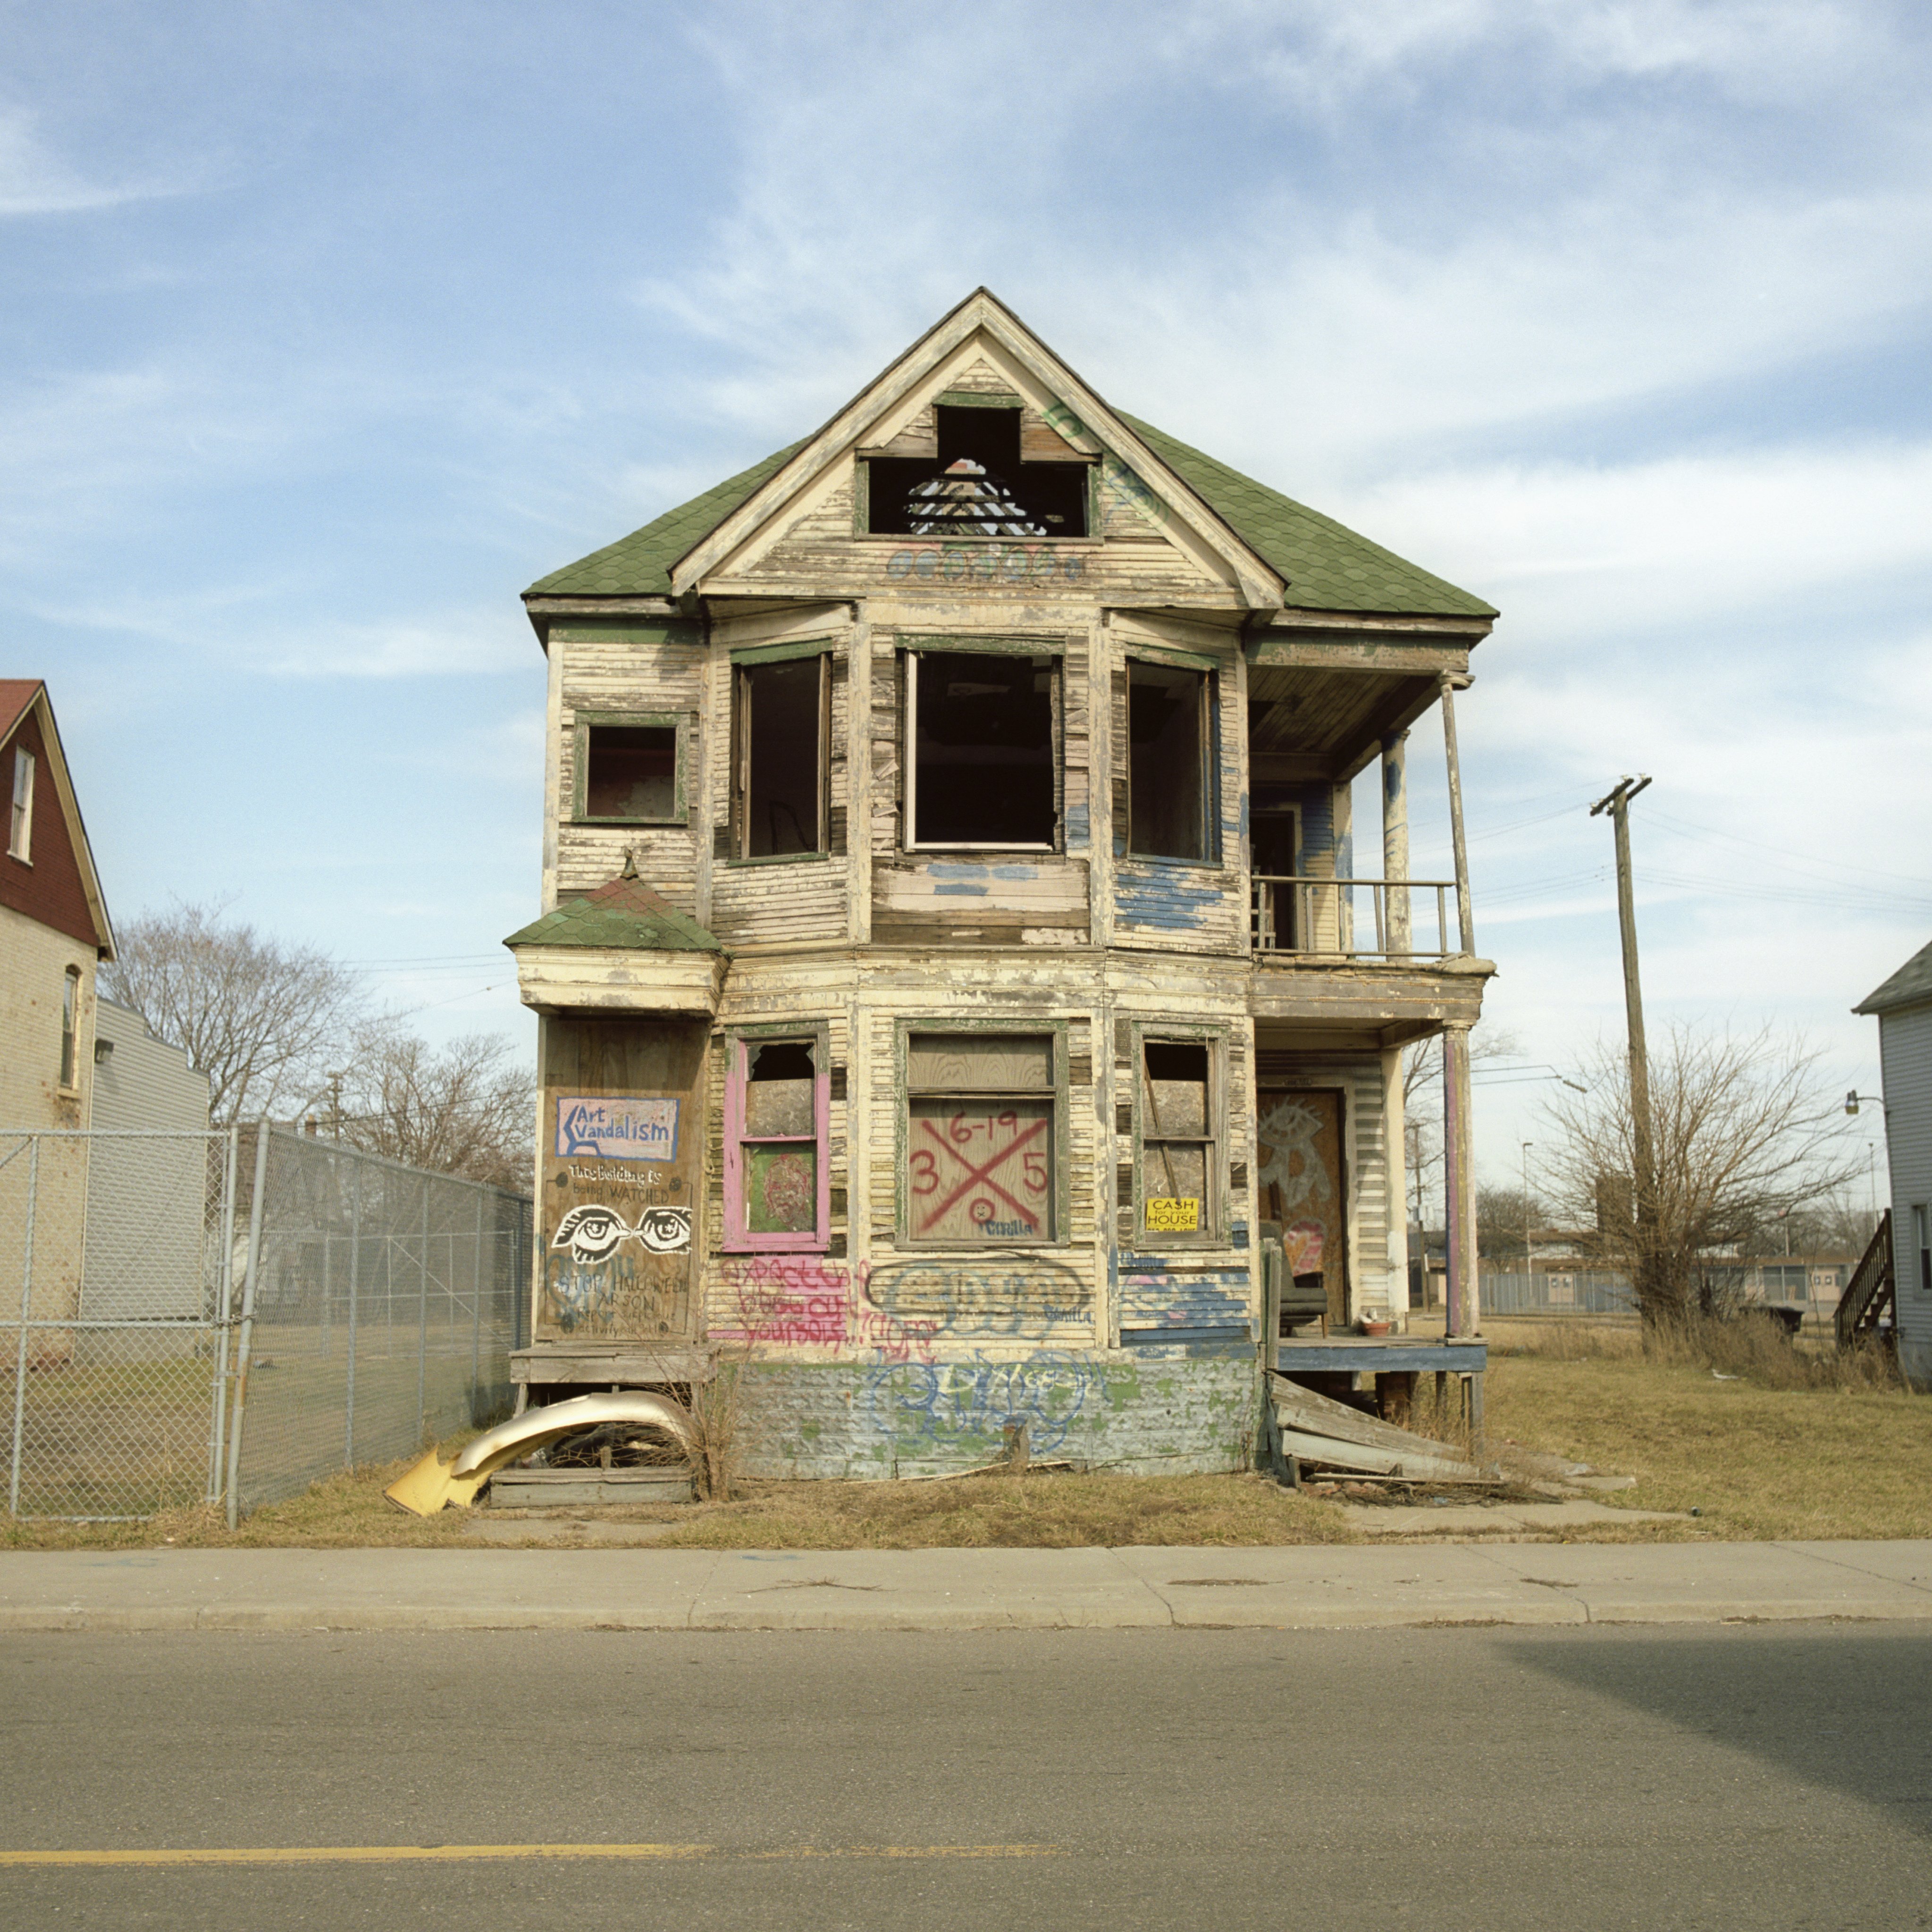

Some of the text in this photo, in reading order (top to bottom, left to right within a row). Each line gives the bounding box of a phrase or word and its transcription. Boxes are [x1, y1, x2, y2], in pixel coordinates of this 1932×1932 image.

[577, 1105, 606, 1123] Art
[574, 1115, 669, 1141] Vandalism
[950, 1110, 1018, 1143] 6-19
[909, 1150, 940, 1195] 3
[1023, 1152, 1048, 1192] 5
[573, 1183, 669, 1204] being WATCHED
[1152, 1200, 1194, 1210] CASH
[1148, 1215, 1197, 1225] HOUSE
[559, 1274, 603, 1294] STOP
[598, 1291, 655, 1311] ARSON
